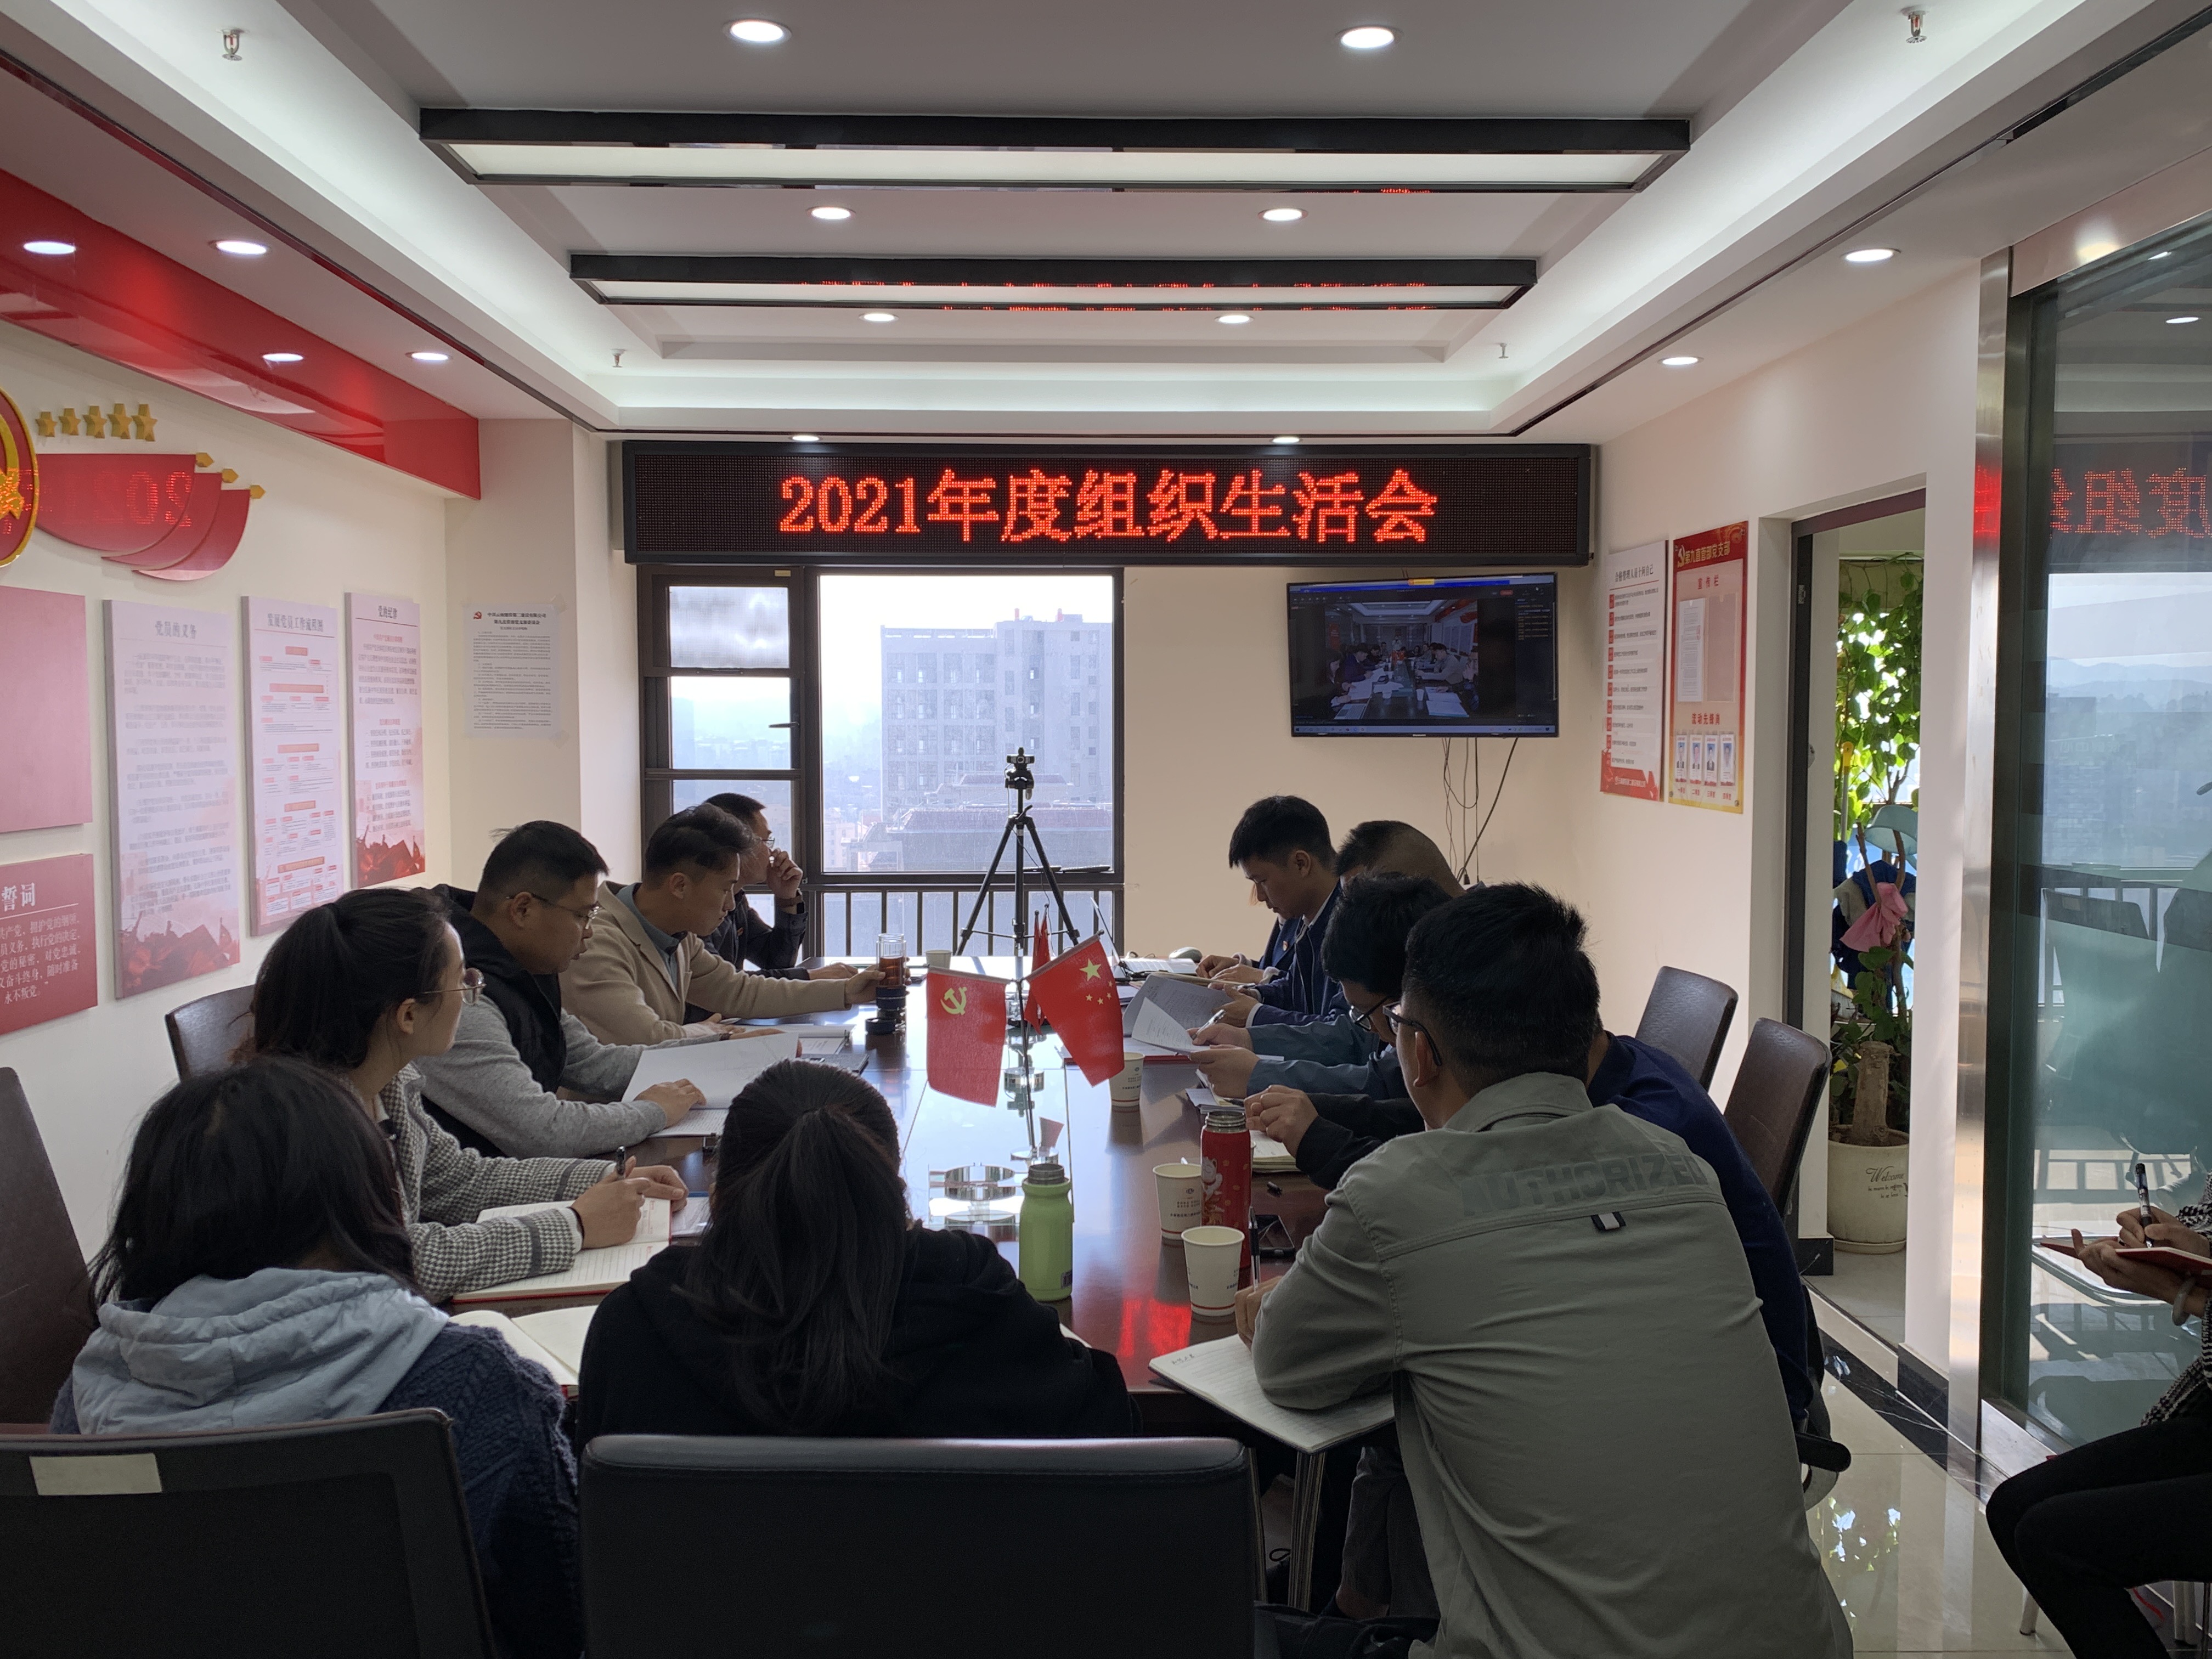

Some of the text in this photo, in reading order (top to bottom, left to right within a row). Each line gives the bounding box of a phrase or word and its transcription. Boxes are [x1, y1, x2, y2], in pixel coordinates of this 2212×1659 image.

[780, 469, 1438, 542] 2021年度组织生活会
[1684, 540, 1731, 565] 第九直管部党支部
[155, 620, 196, 639] 党员的义务
[1, 882, 36, 912] 誓词
[1460, 1153, 1708, 1217] AUTHORIZED
[1865, 1166, 1905, 1183] Welcome
